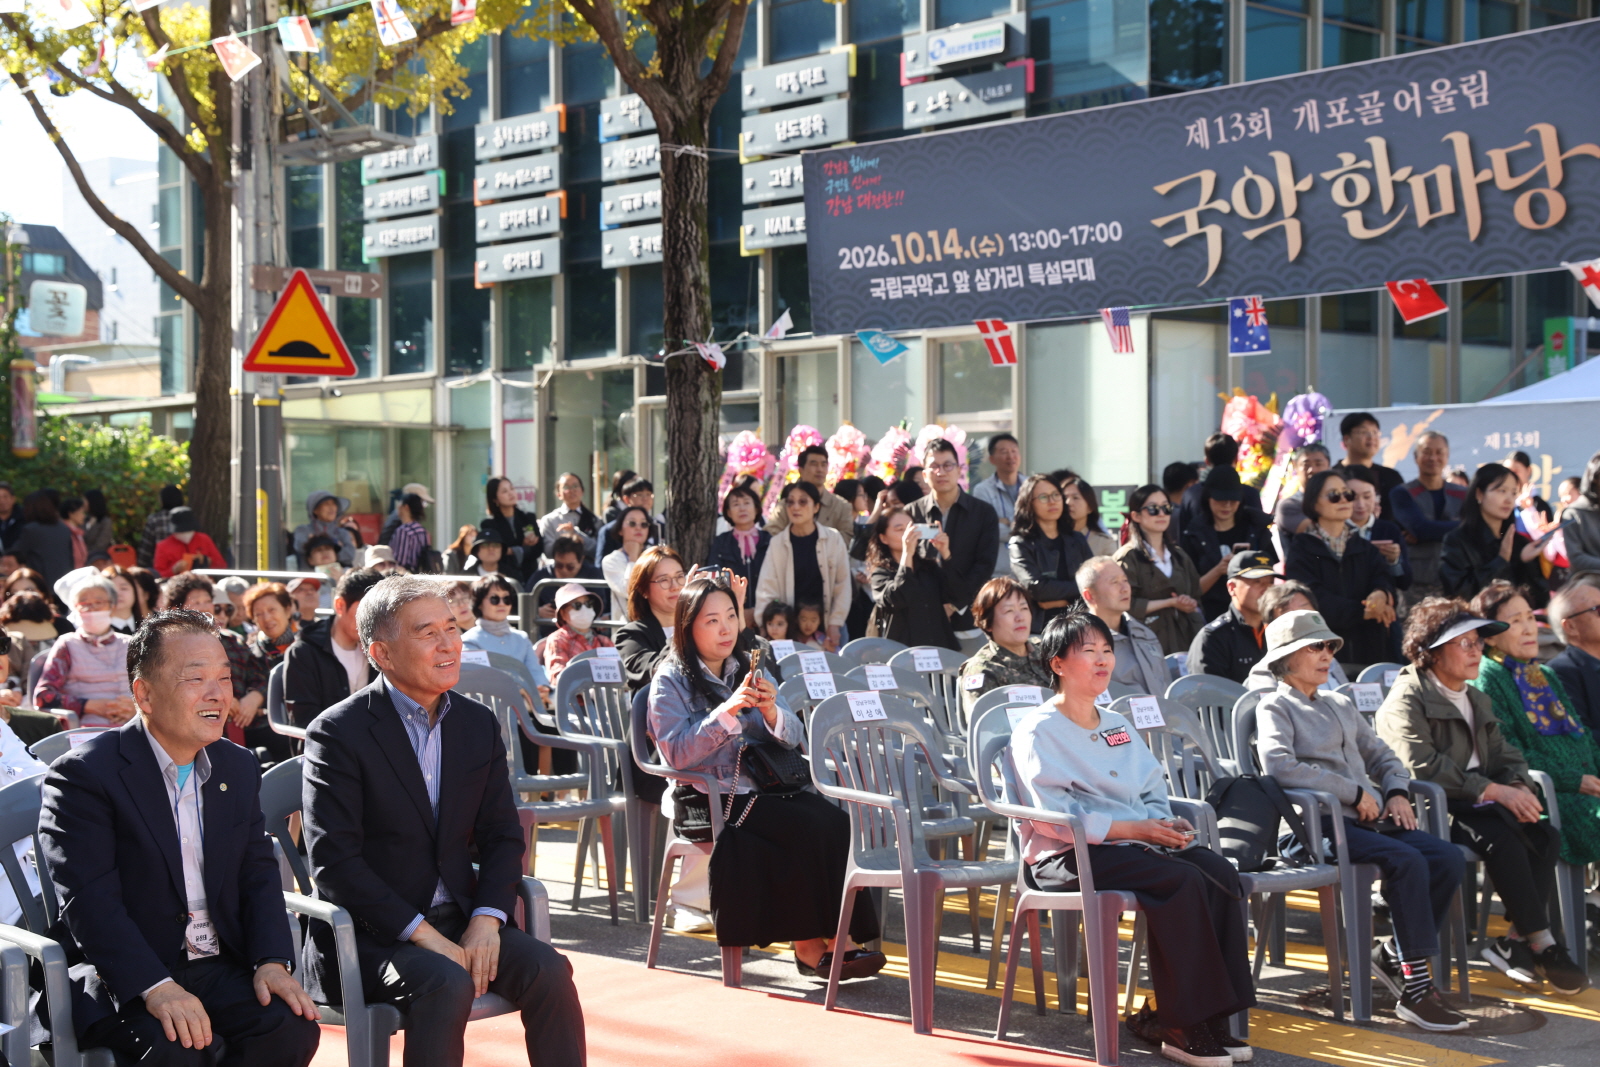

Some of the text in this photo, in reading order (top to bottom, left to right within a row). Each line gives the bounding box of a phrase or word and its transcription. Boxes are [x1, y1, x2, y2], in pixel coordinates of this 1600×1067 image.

[1185, 70, 1490, 150] 제13회 개포골 어울림
[826, 194, 853, 217] 강남
[1150, 122, 1600, 288] 국악 한마당
[838, 221, 1122, 270] 2026.10.14.(수) 13:00-17:00
[869, 257, 1096, 300] 국립국악고 앞 삼거리 특설무대
[1483, 430, 1541, 450] 제13회
